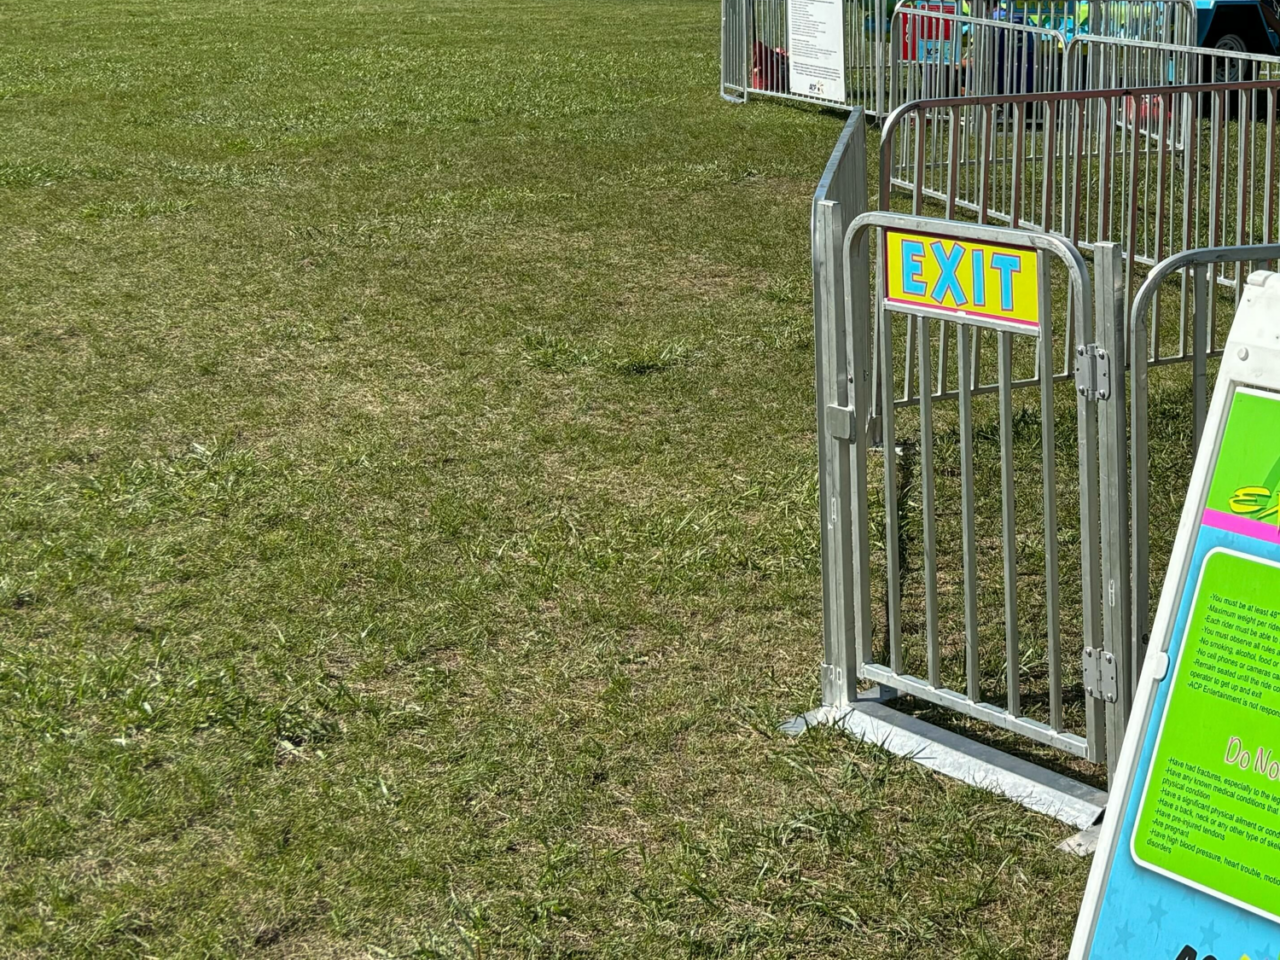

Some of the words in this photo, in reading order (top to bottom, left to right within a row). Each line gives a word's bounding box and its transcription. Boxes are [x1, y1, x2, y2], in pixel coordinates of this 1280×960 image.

[901, 239, 1021, 312] EXIT
[1223, 597, 1238, 607] must
[1237, 601, 1246, 610] be
[1246, 604, 1254, 612] at
[1253, 606, 1269, 616] least
[1220, 620, 1234, 630] rider
[1234, 624, 1250, 634] must
[1249, 628, 1258, 637] be
[1257, 631, 1272, 641] able
[1271, 635, 1279, 644] to
[1236, 613, 1256, 625] weight
[1256, 619, 1267, 627] per
[1214, 630, 1229, 640] must
[1229, 635, 1252, 647] observe
[1252, 641, 1261, 650] all
[1260, 644, 1276, 655] rules
[1206, 651, 1217, 660] cell
[1216, 655, 1238, 667] phones
[1245, 664, 1271, 678] cameras
[1257, 654, 1272, 666] food
[1202, 684, 1242, 704] Entertainment
[1241, 697, 1248, 707] is
[1248, 701, 1259, 710] not
[1224, 736, 1251, 770] Do
[1181, 773, 1193, 784] any
[1193, 777, 1212, 790] known
[1212, 785, 1236, 798] medical
[1235, 793, 1266, 810] conditions
[1266, 804, 1279, 815] that
[1184, 762, 1197, 773] had
[1223, 778, 1252, 794] especially
[1252, 787, 1260, 796] to
[1259, 789, 1271, 800] the
[1163, 823, 1190, 838] pregnant
[1171, 814, 1202, 832] pre-injured
[1202, 825, 1225, 841] tendons
[1146, 837, 1172, 854] disorders
[1166, 834, 1178, 846] high
[1178, 839, 1196, 852] blood
[1223, 856, 1240, 870] heart
